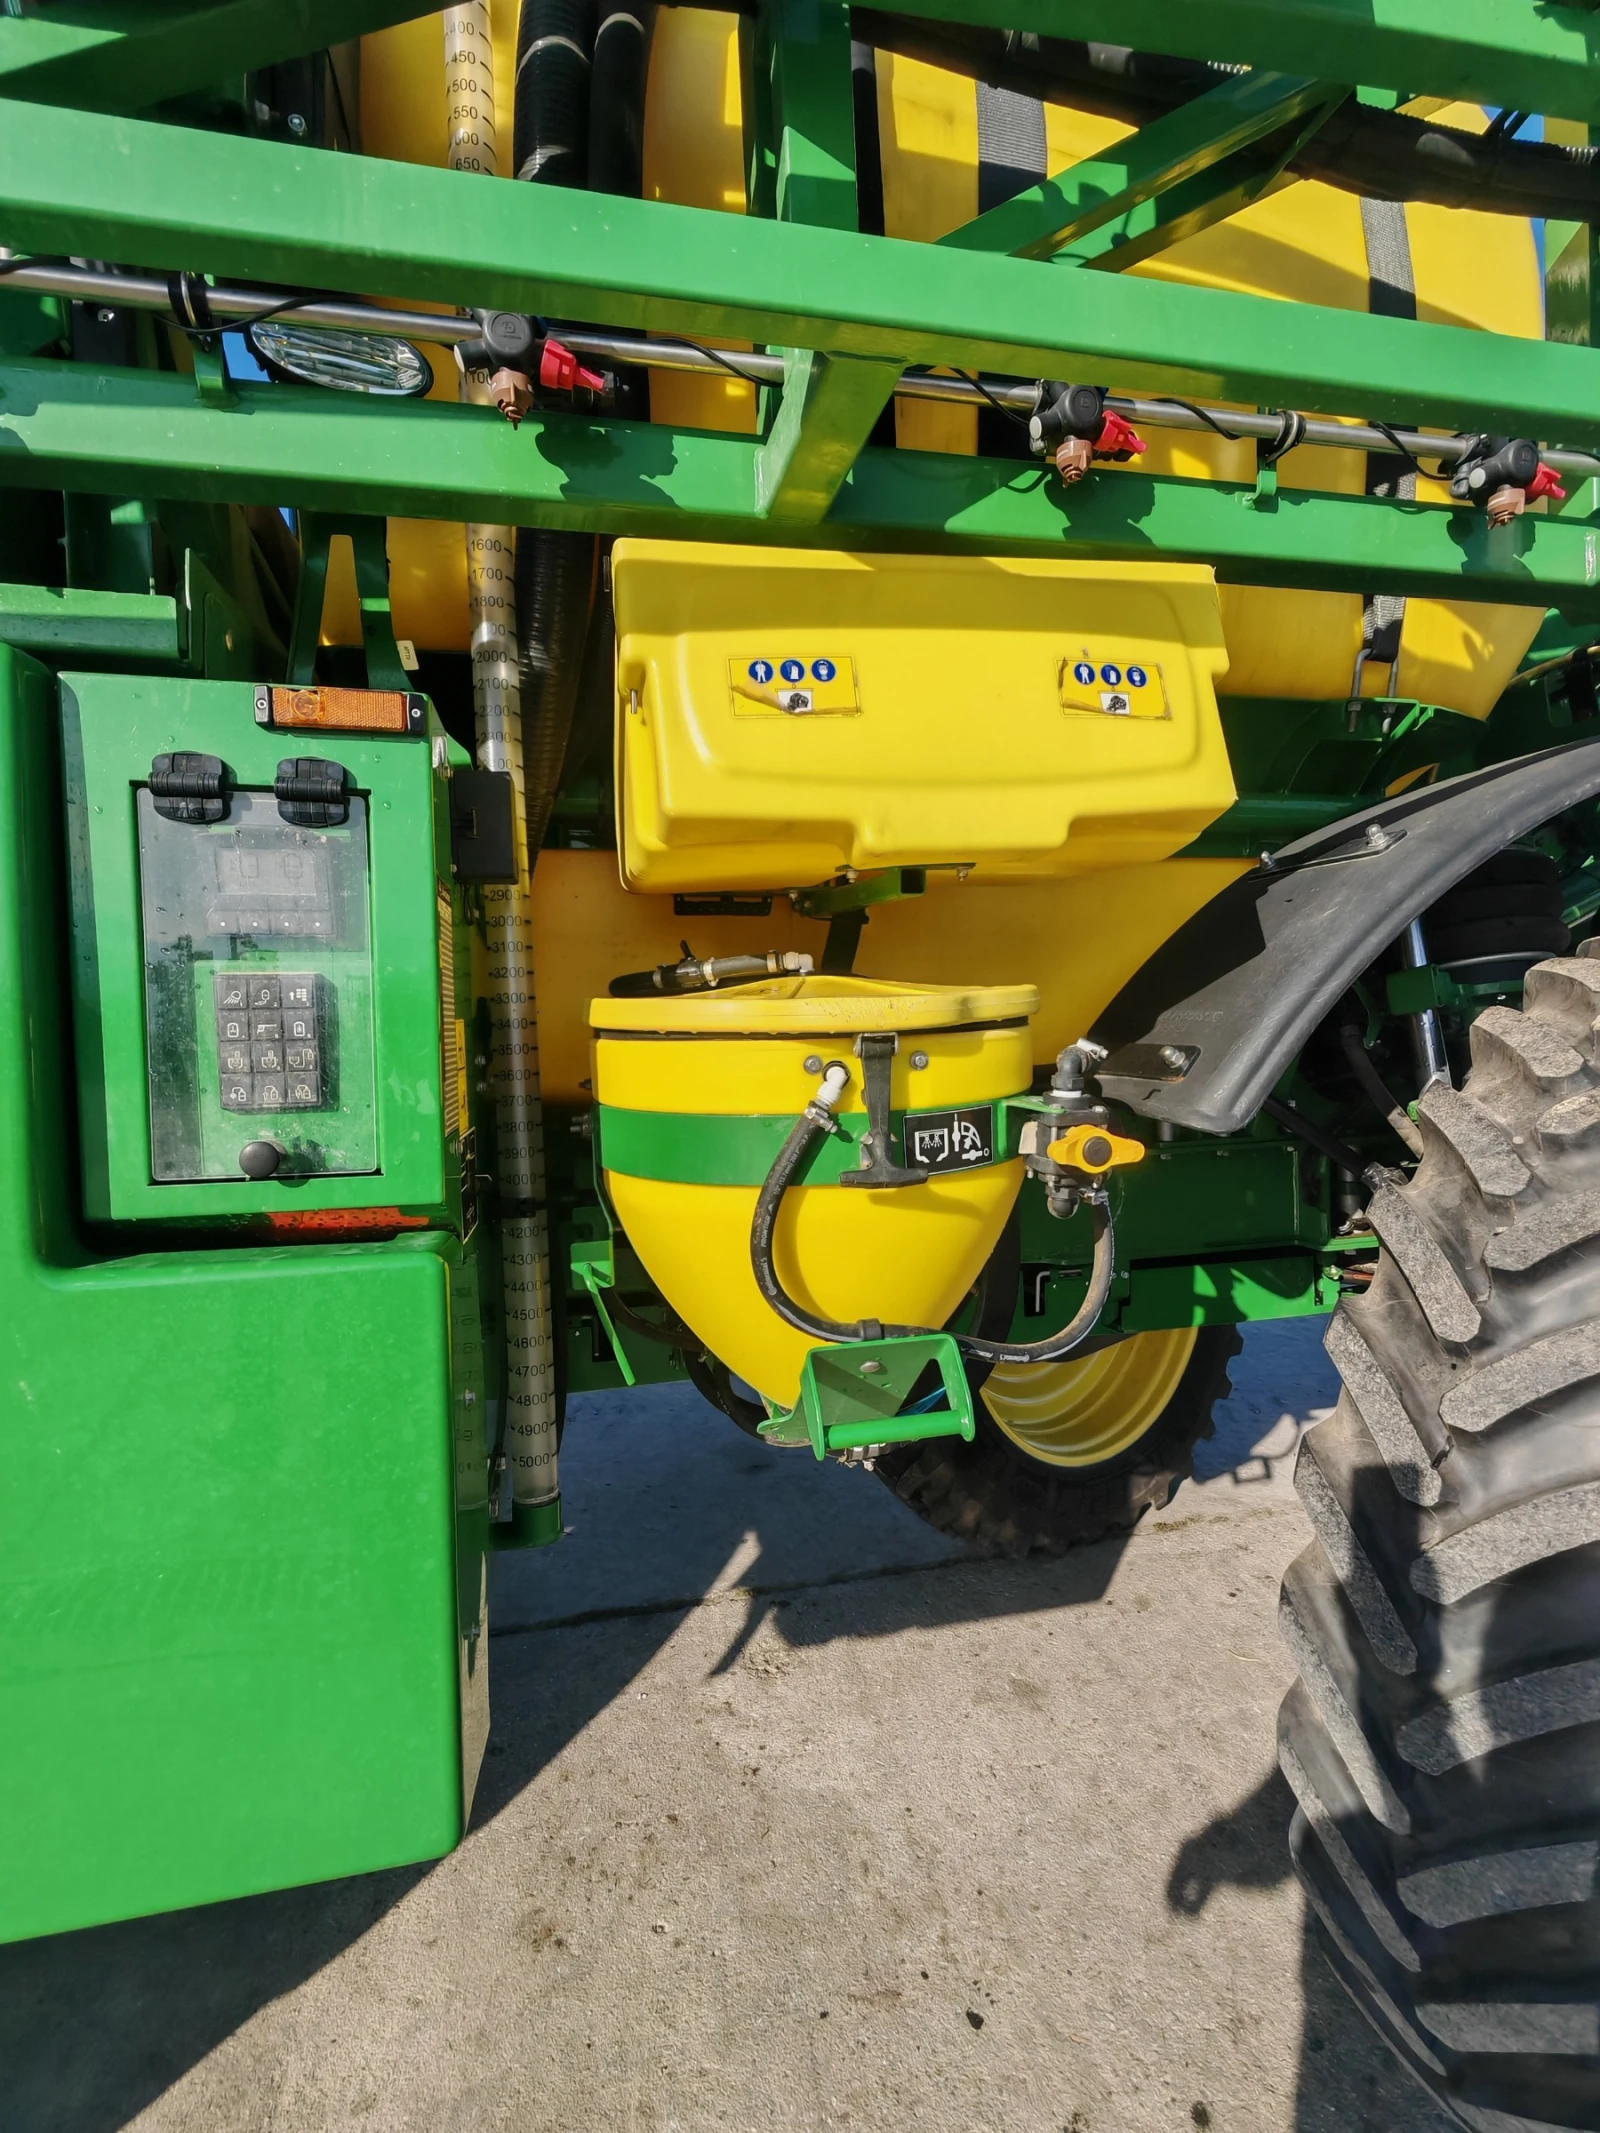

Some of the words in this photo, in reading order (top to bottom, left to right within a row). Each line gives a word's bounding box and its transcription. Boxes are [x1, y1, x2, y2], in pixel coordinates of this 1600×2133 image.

[449, 20, 475, 36] 400
[451, 50, 476, 64] 450
[452, 78, 477, 93] 500
[453, 105, 478, 119] 550
[455, 157, 480, 171] 650
[470, 538, 502, 553] 1600
[471, 567, 503, 581] 1700
[473, 595, 504, 608] 1800
[476, 650, 507, 664] 2000
[477, 677, 509, 691] 2100
[479, 704, 510, 717] 2200
[481, 731, 512, 744] 2300
[489, 889, 521, 902] 2900
[491, 915, 522, 927] 3000
[492, 941, 524, 953] 3100
[493, 966, 525, 979] 3200
[495, 992, 527, 1004] 3300
[497, 1017, 528, 1029] 3400
[498, 1043, 530, 1055] 3500
[500, 1069, 531, 1082] 3600
[501, 1094, 533, 1107] 3700
[502, 1120, 534, 1133] 3800
[504, 1147, 535, 1159] 3900
[506, 1173, 537, 1186] 4000
[508, 1225, 540, 1239] 4200
[760, 1215, 771, 1248] FRONTIER
[509, 1252, 541, 1266] 4300
[510, 1279, 542, 1293] 4400
[511, 1307, 544, 1321] 4500
[513, 1334, 545, 1349] 4600
[515, 1363, 546, 1378] 4700
[516, 1392, 548, 1407] 4800
[517, 1421, 549, 1436] 4900
[519, 1452, 550, 1468] 5000
